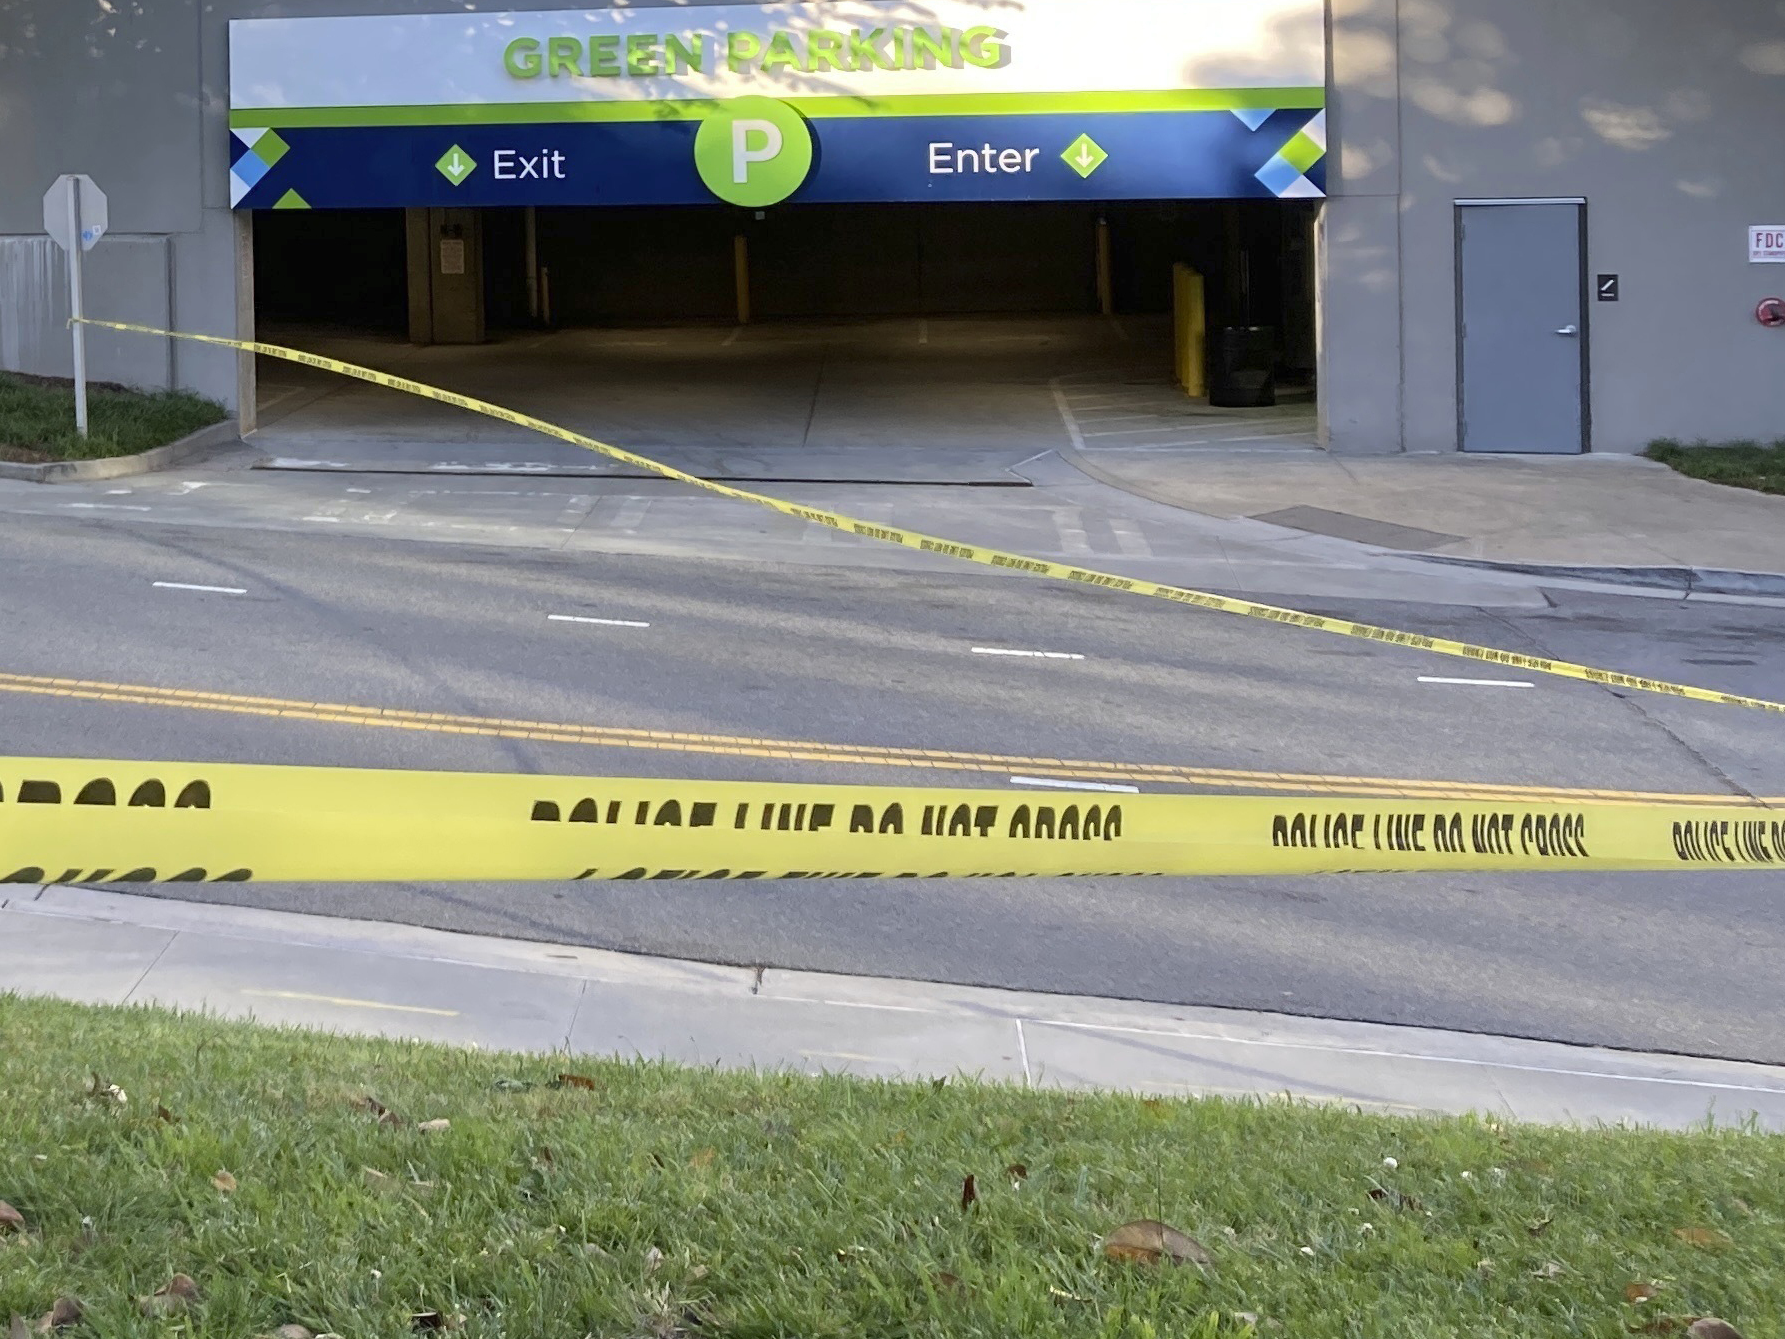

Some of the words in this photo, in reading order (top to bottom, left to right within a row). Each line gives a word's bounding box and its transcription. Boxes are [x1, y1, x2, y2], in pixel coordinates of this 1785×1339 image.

[503, 33, 703, 79] GREEN
[726, 25, 1001, 73] PARKING
[493, 148, 567, 180] Exit
[732, 119, 783, 184] P
[929, 142, 1040, 173] Enter
[1755, 232, 1784, 249] FDC
